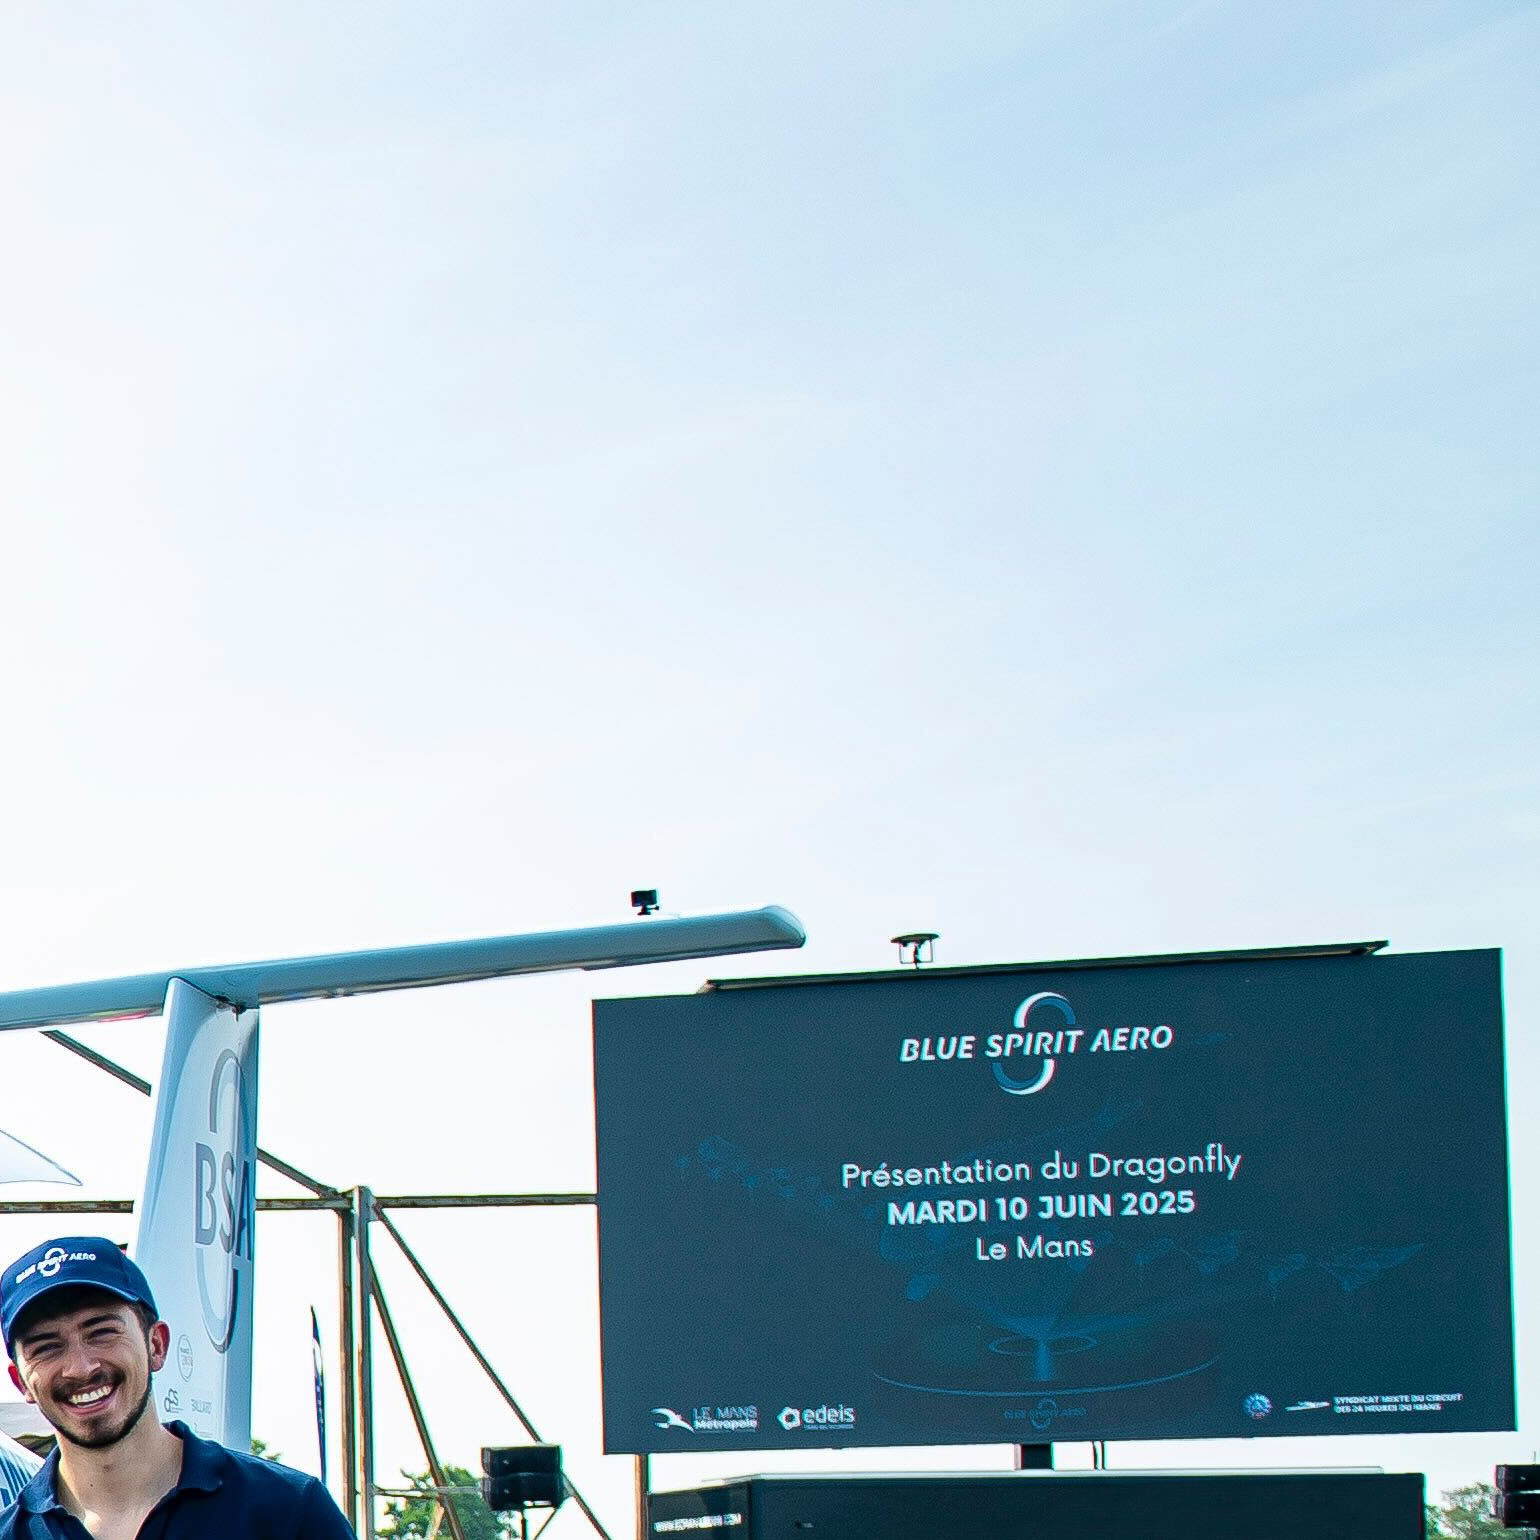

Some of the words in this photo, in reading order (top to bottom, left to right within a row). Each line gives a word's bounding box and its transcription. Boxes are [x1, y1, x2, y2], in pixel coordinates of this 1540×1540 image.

[900, 1035, 977, 1063] BLUE
[984, 1029, 1085, 1058] SPIRIT
[1089, 1025, 1176, 1053] AERO
[840, 1158, 1031, 1188] Présentation
[1041, 1150, 1079, 1180] du
[1088, 1143, 1242, 1184] Dragonfly
[195, 1141, 253, 1262] BSA
[886, 1199, 988, 1226] MARDI
[995, 1196, 1029, 1222] 10
[1037, 1193, 1113, 1220] JUIN
[1120, 1190, 1196, 1217] 2025
[975, 1237, 1008, 1261] Le
[1016, 1234, 1095, 1259] Mans
[692, 1407, 710, 1420] LE
[716, 1405, 759, 1419] MANS
[802, 1404, 844, 1424] edeis
